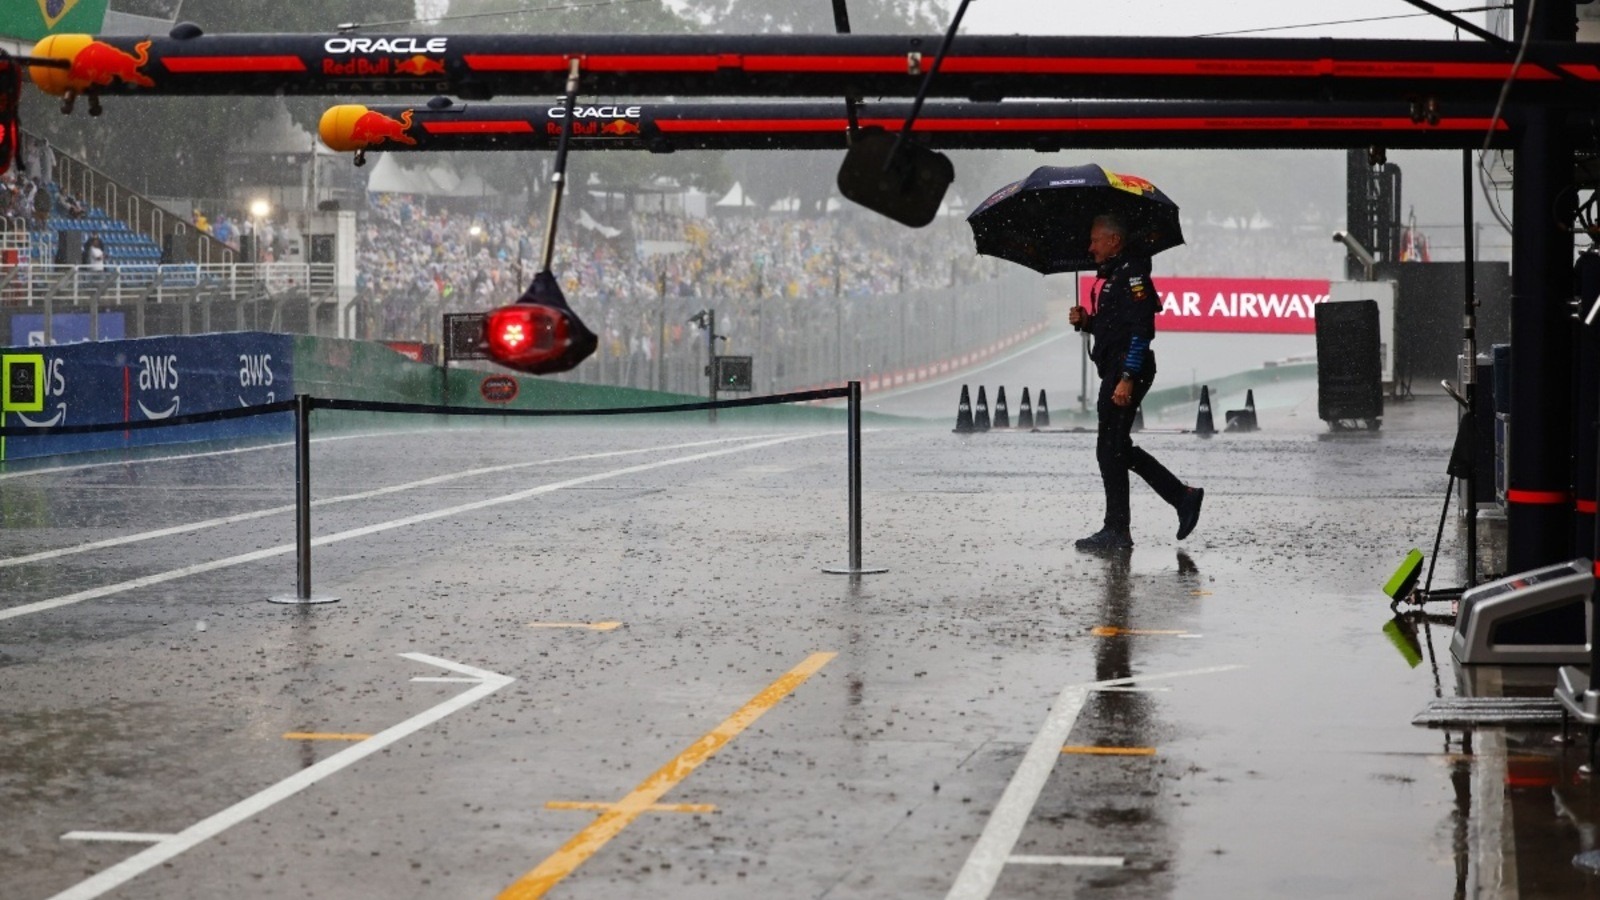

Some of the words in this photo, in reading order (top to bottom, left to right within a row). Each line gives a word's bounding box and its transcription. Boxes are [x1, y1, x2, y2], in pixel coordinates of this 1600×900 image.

[325, 38, 448, 53] ORACLE
[547, 106, 642, 118] ORACLE
[139, 354, 180, 391] aws
[239, 354, 273, 387] aws
